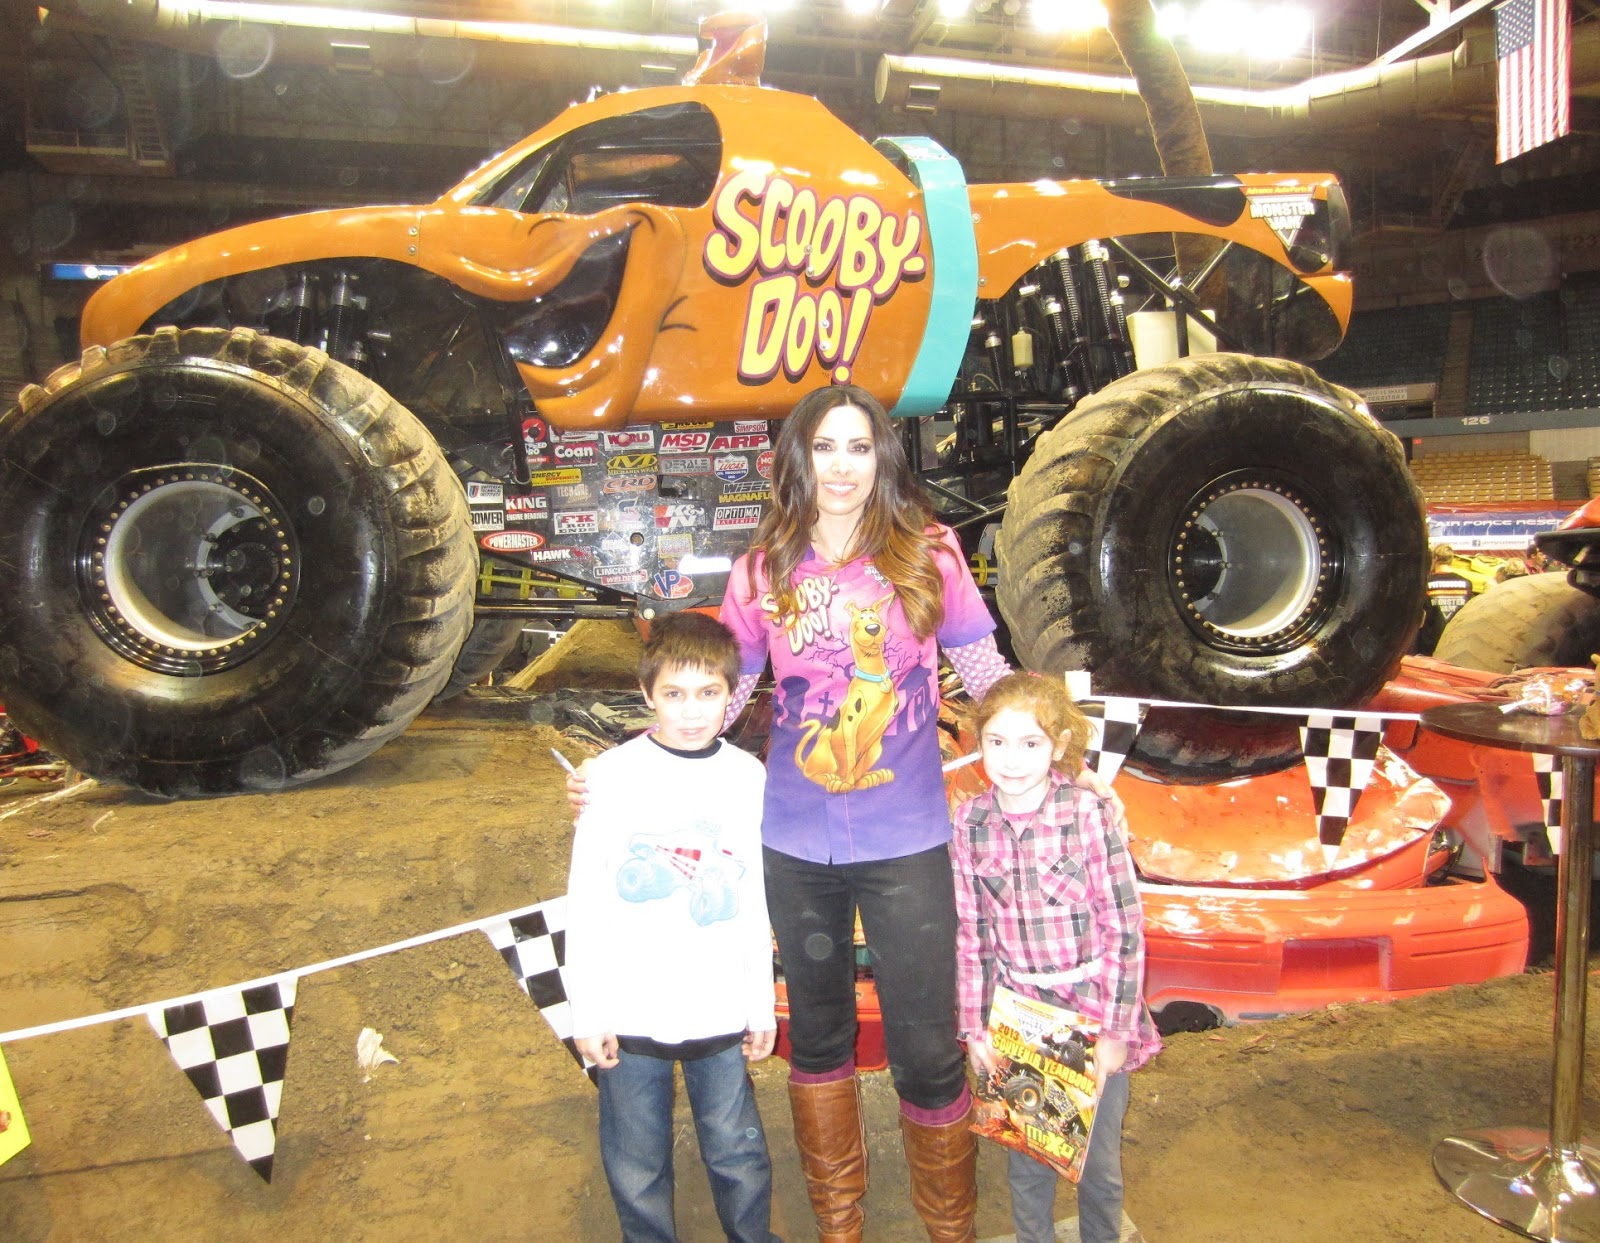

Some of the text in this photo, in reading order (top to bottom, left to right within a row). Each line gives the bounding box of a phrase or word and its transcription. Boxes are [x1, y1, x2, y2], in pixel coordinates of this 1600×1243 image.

[1250, 201, 1315, 218] MONSTER
[1270, 216, 1302, 230] JAM
[1461, 416, 1491, 426] 126
[736, 423, 766, 433] SIMPSON
[607, 432, 651, 448] WORLD
[662, 433, 707, 448] MSD
[711, 435, 769, 450] ARP
[554, 445, 594, 458] Coan
[664, 459, 708, 470] DERALE
[718, 462, 746, 470] LUCAS
[531, 471, 562, 479] ENERGY
[505, 497, 547, 511] KING
[507, 511, 548, 521] ENGINE BEARINGS
[561, 514, 595, 524] FK
[664, 504, 705, 528] K&N
[717, 506, 760, 519] OPTIMA
[1435, 519, 1461, 527] AIR
[1463, 519, 1513, 527] FORCE
[489, 533, 538, 548] POWERMASTER
[533, 549, 572, 561] HAWK
[654, 570, 681, 598] VP
[998, 1022, 1021, 1042] 2013
[992, 1033, 1096, 1097] SOUVENIR YEARBOOK
